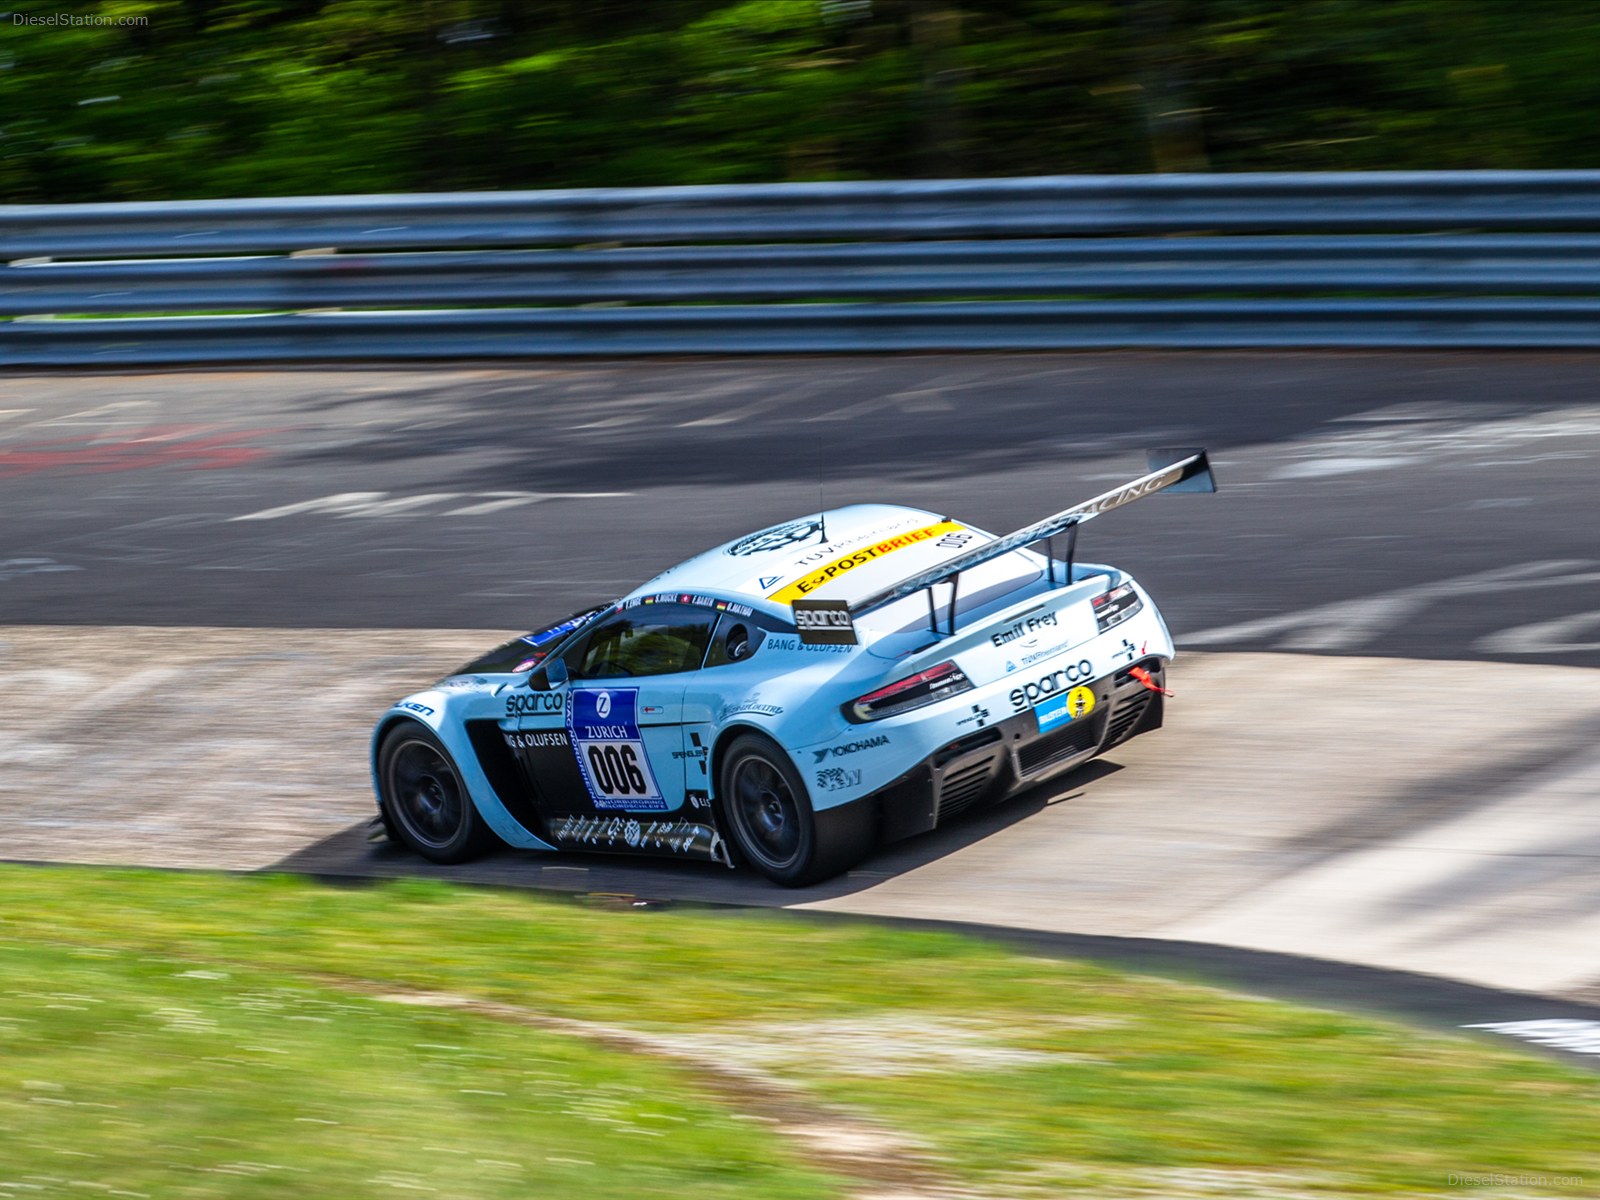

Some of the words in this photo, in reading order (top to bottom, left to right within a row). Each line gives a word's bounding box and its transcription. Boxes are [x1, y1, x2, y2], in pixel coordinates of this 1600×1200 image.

[795, 610, 852, 630] sparco
[991, 621, 1026, 648] Emil
[1027, 611, 1058, 633] Frey
[767, 639, 796, 651] BANG
[1010, 659, 1092, 708] sparco
[505, 692, 563, 718] sparco
[516, 735, 526, 748] &
[525, 733, 568, 747] OLUFSEN
[585, 725, 628, 739] ZURICH
[828, 735, 891, 757] YOKOHAMA
[588, 745, 647, 794] 006
